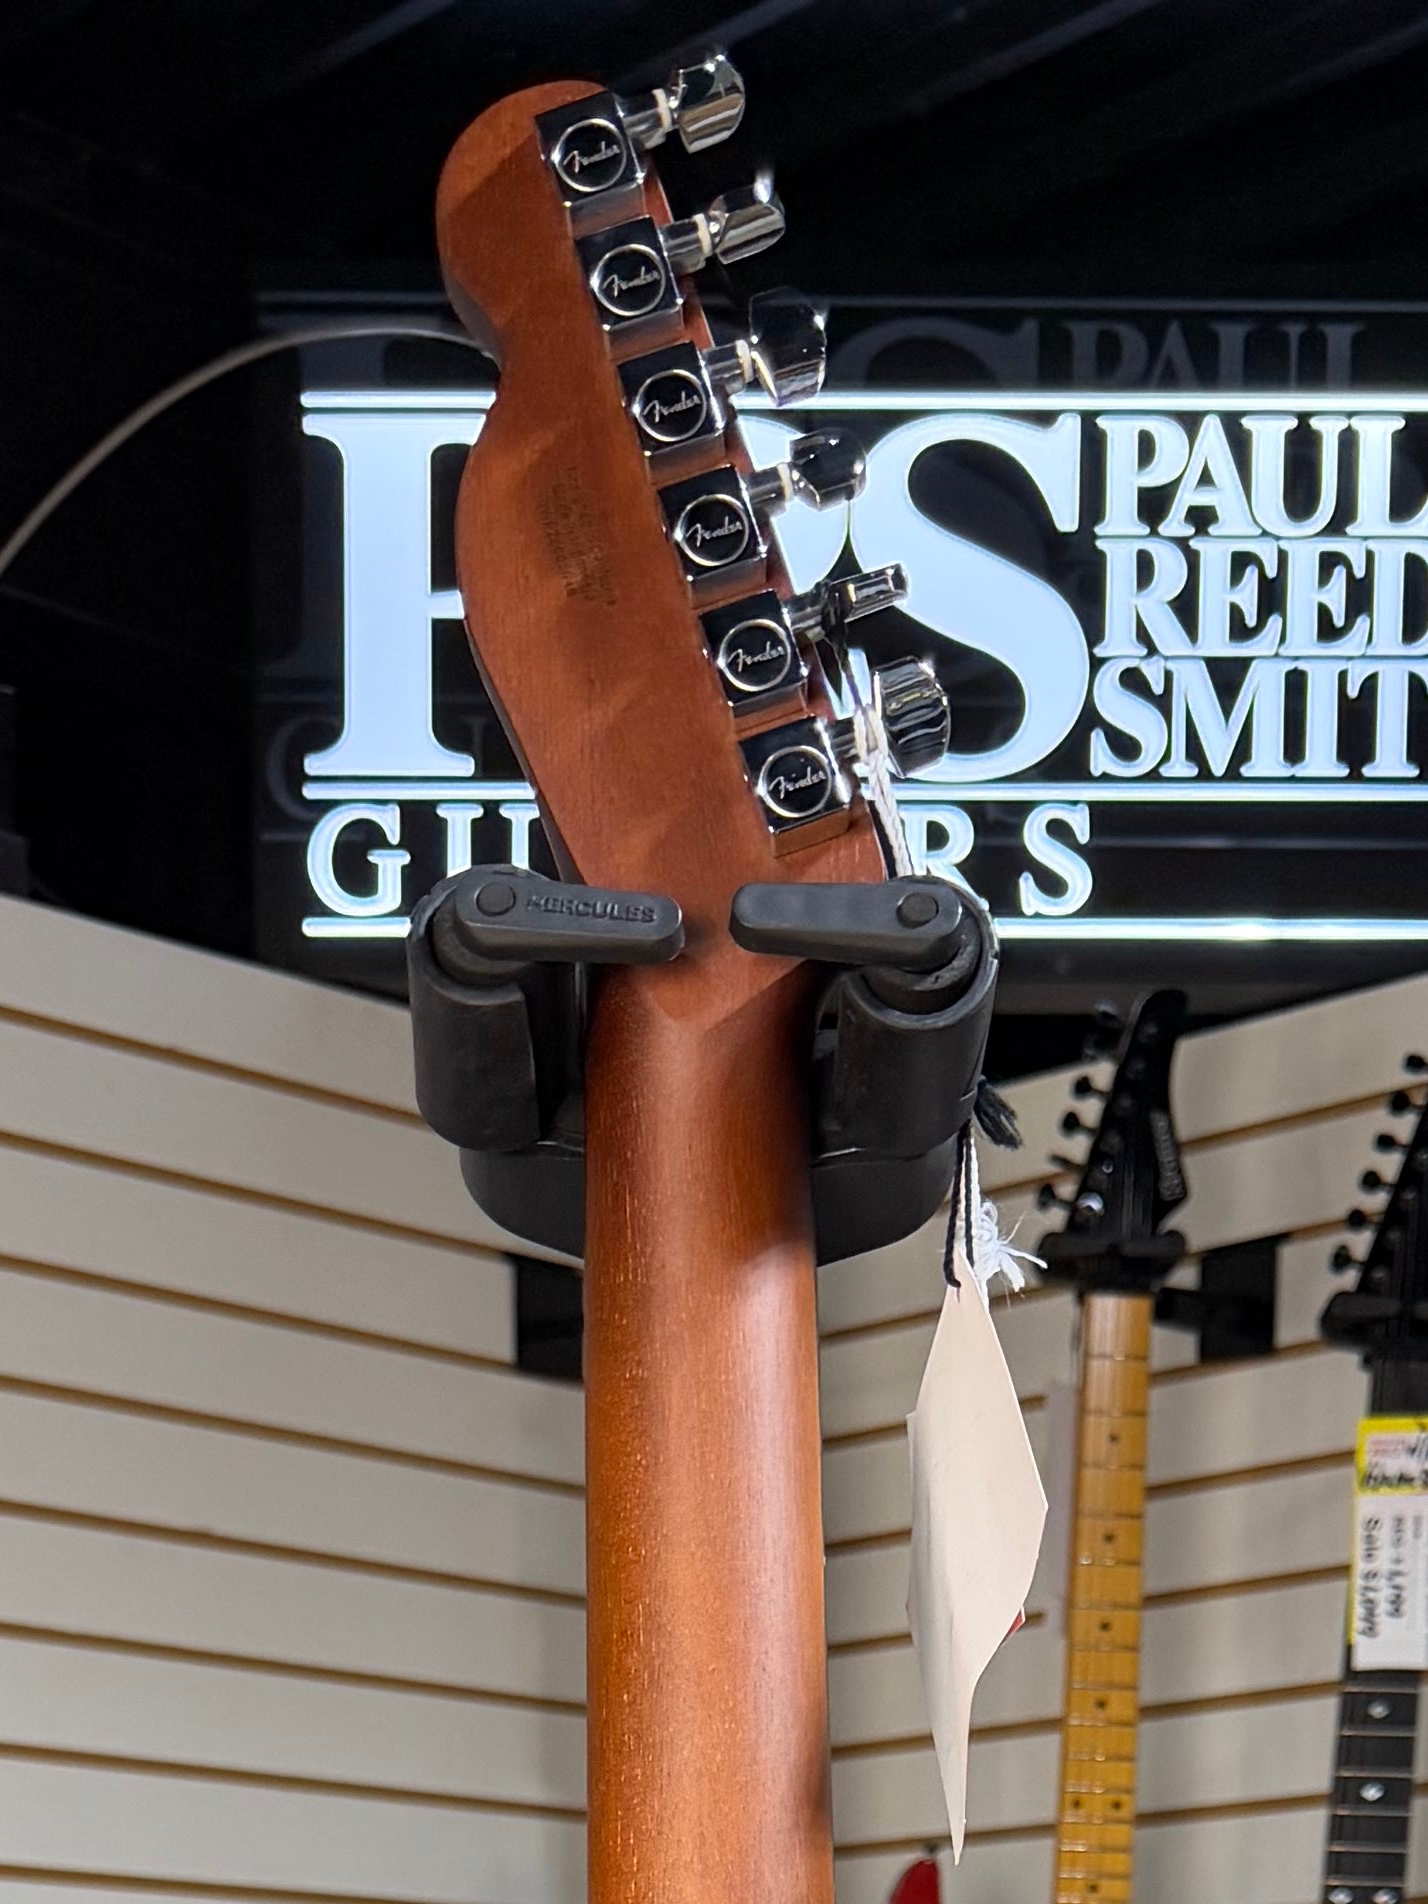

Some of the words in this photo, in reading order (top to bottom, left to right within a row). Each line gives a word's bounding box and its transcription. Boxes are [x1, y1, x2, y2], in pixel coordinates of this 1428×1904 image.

[563, 141, 621, 171] Fender
[602, 268, 659, 296] Fender
[643, 391, 700, 421] Fender
[685, 518, 744, 547] Fender
[726, 641, 785, 670] Fender
[768, 767, 827, 796] Fender
[527, 894, 656, 924] HERCULES
